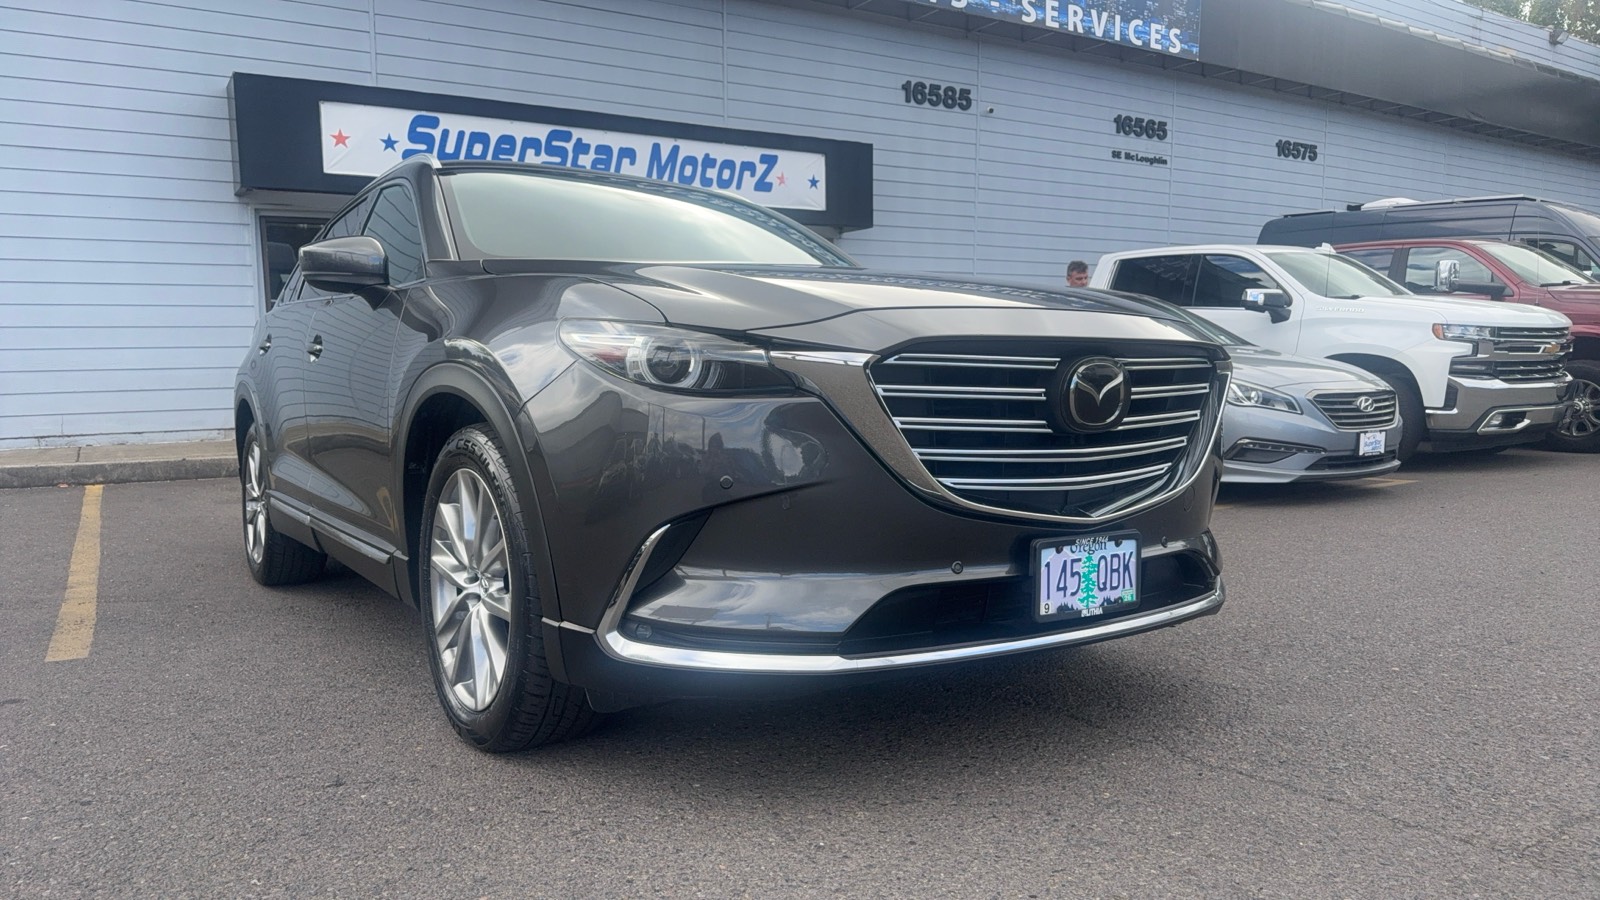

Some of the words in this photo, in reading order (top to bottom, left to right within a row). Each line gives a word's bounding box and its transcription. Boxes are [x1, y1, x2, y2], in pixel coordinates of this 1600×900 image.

[1021, 0, 1182, 54] SERVICES
[901, 80, 972, 111] 16585
[1113, 114, 1168, 141] 16565
[401, 114, 638, 174] SuperStar
[646, 142, 779, 193] MotorZ
[1111, 150, 1122, 160] SE
[1275, 139, 1318, 162] 16575
[1070, 541, 1108, 556] Oregon
[1045, 558, 1082, 601] 145
[1097, 551, 1133, 592] QBK
[1043, 603, 1050, 614] 9
